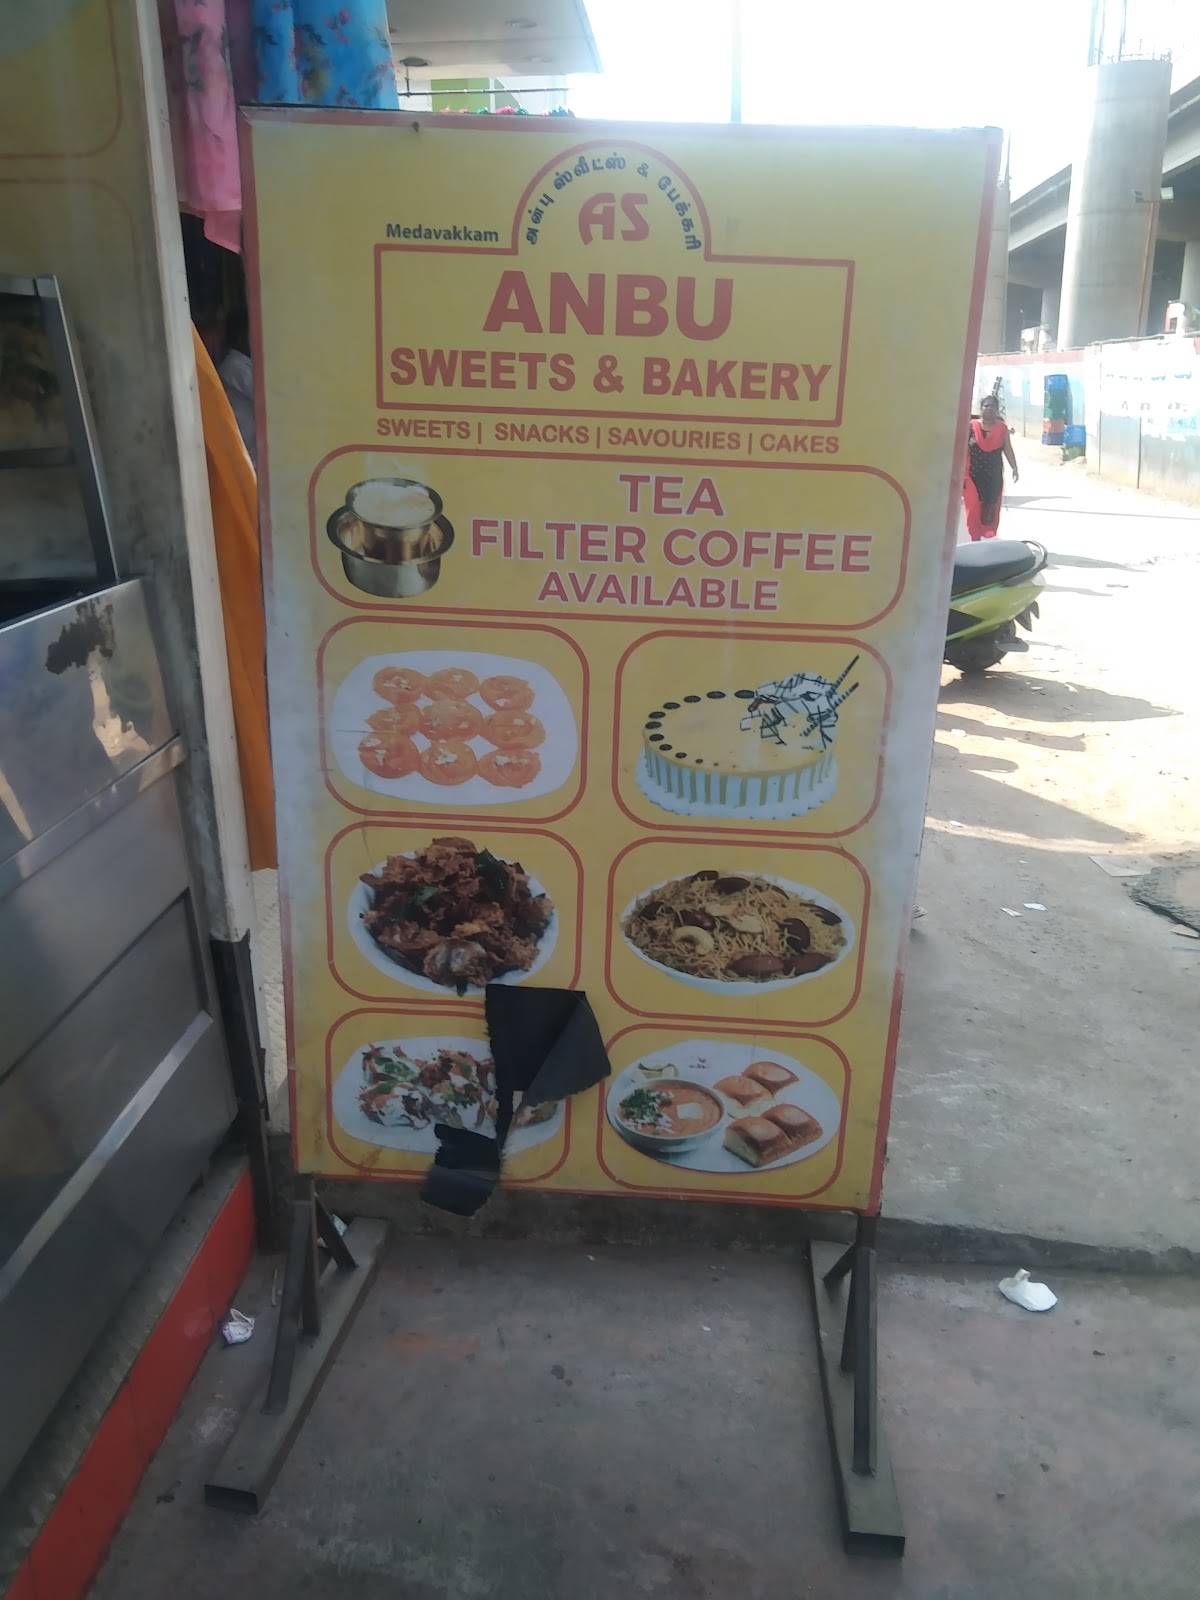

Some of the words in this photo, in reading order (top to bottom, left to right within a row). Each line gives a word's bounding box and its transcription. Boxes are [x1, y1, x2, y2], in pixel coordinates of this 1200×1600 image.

[386, 223, 499, 242] Medavakkam
[578, 192, 650, 246] AS
[483, 270, 734, 341] ANBU
[390, 347, 576, 392] SWEETS
[593, 354, 625, 394] &
[643, 356, 832, 401] BAKERY
[376, 417, 471, 439] SWEETS
[494, 422, 589, 443] SNACKS
[607, 426, 741, 450] SAVOURIES
[760, 433, 840, 454] CAKES
[619, 474, 725, 517] TEA
[471, 518, 647, 564] FILTER
[662, 528, 873, 573] COFFEE
[538, 570, 779, 611] AVAILABLE
